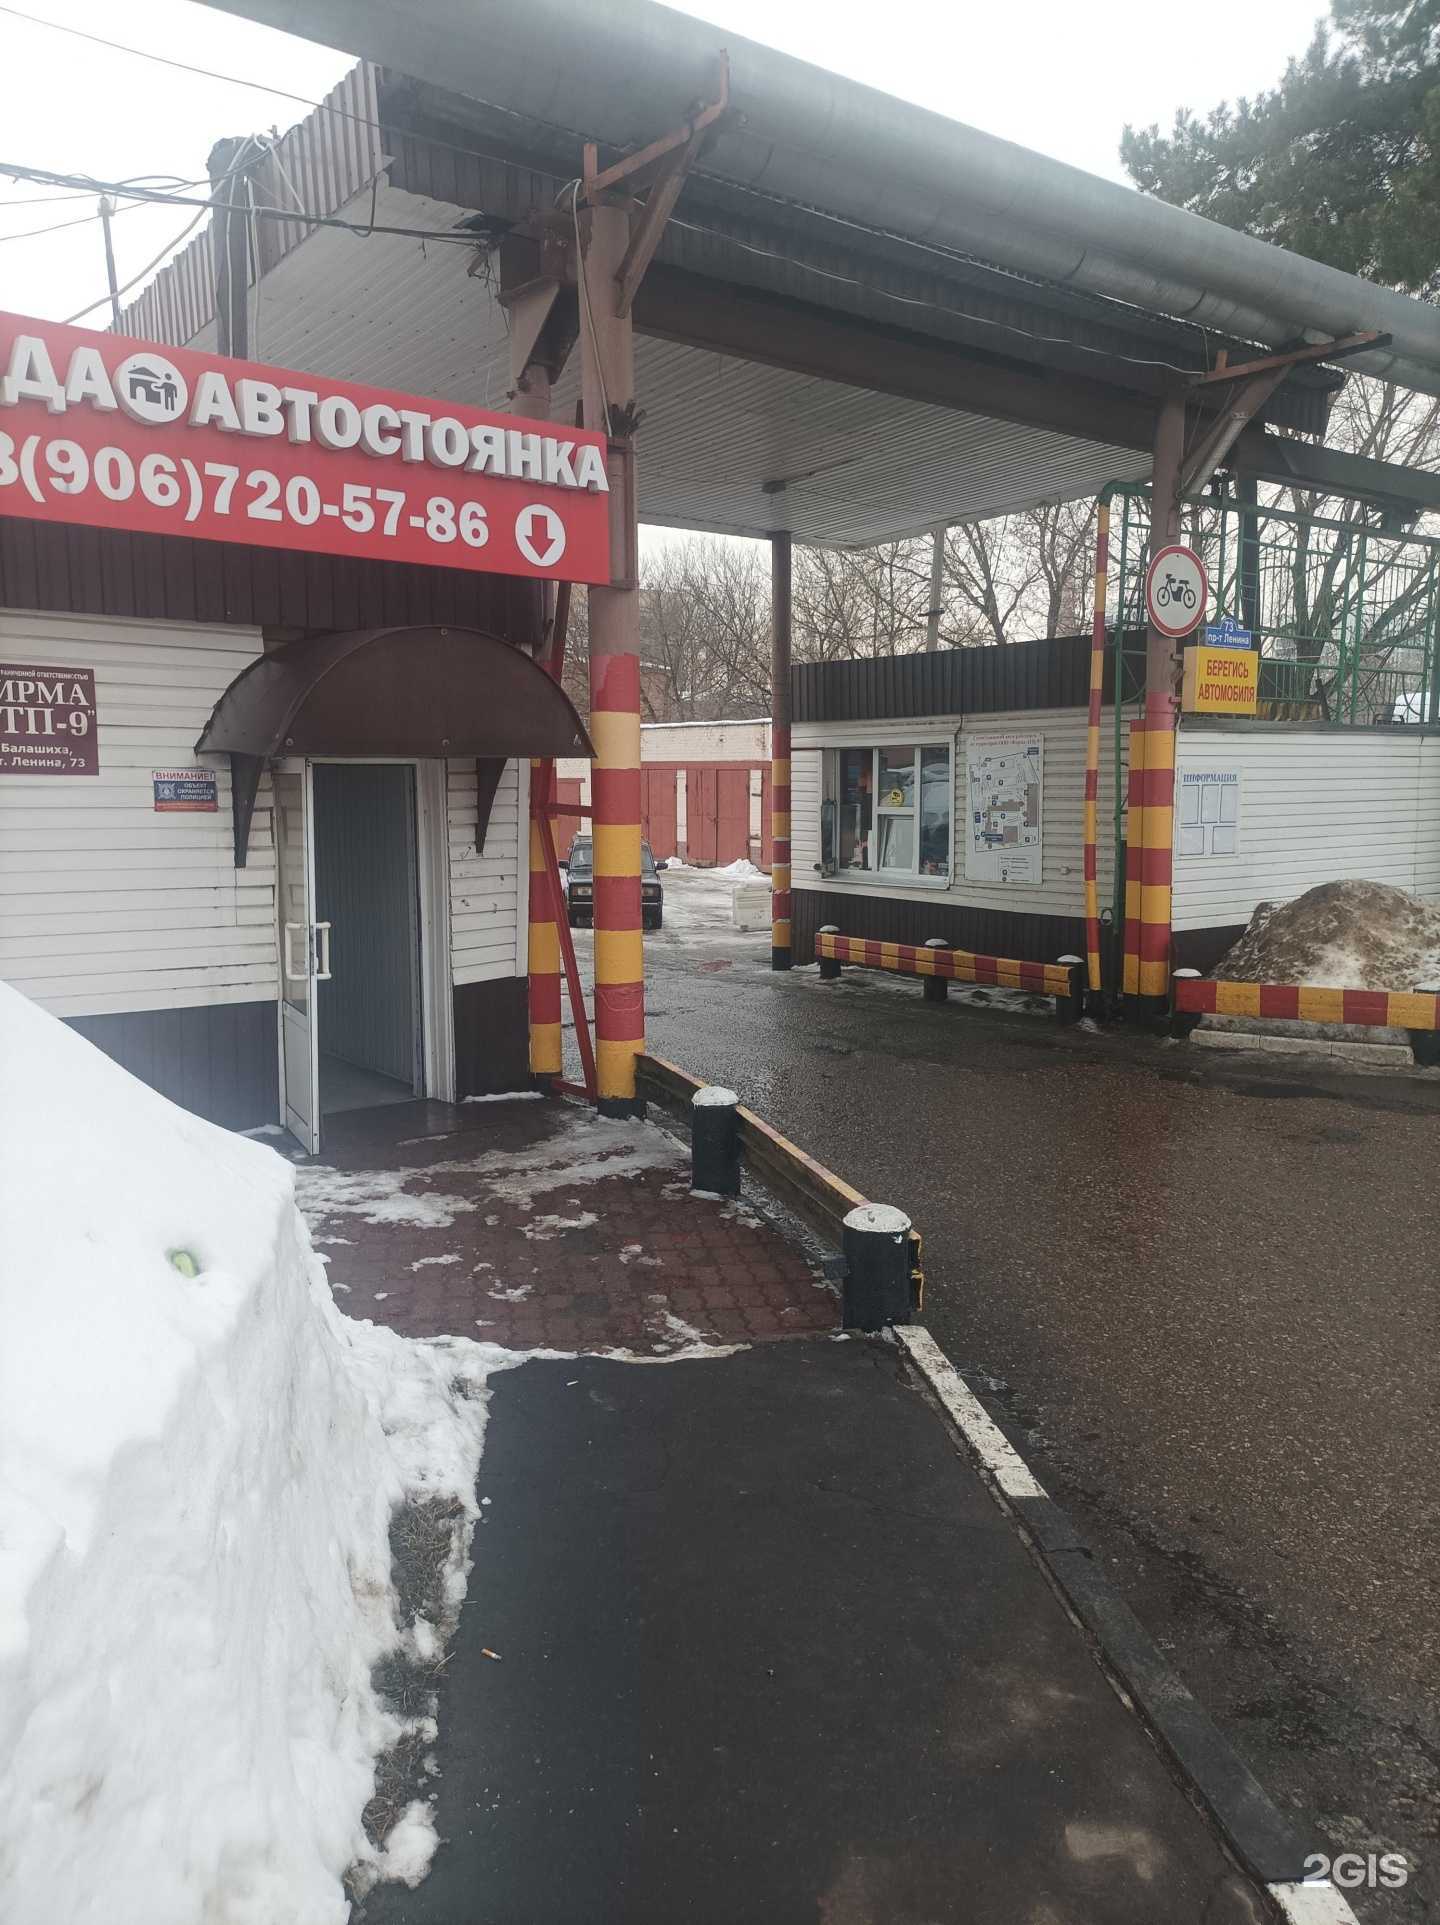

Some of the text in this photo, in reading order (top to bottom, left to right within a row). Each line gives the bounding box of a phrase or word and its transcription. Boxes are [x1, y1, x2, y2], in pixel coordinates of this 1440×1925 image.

[189, 371, 609, 492] АВТОСТОЯНКА
[1225, 621, 1234, 632] 73
[1208, 633, 1249, 644] пр-т Ленина
[1206, 659, 1249, 679] БЕРЕГИСЬ
[1198, 684, 1255, 703] АВТОМОБИЛЯ
[1, 743, 73, 757] Балашиха,
[12, 756, 66, 770] Ленина,
[69, 758, 86, 768] 73
